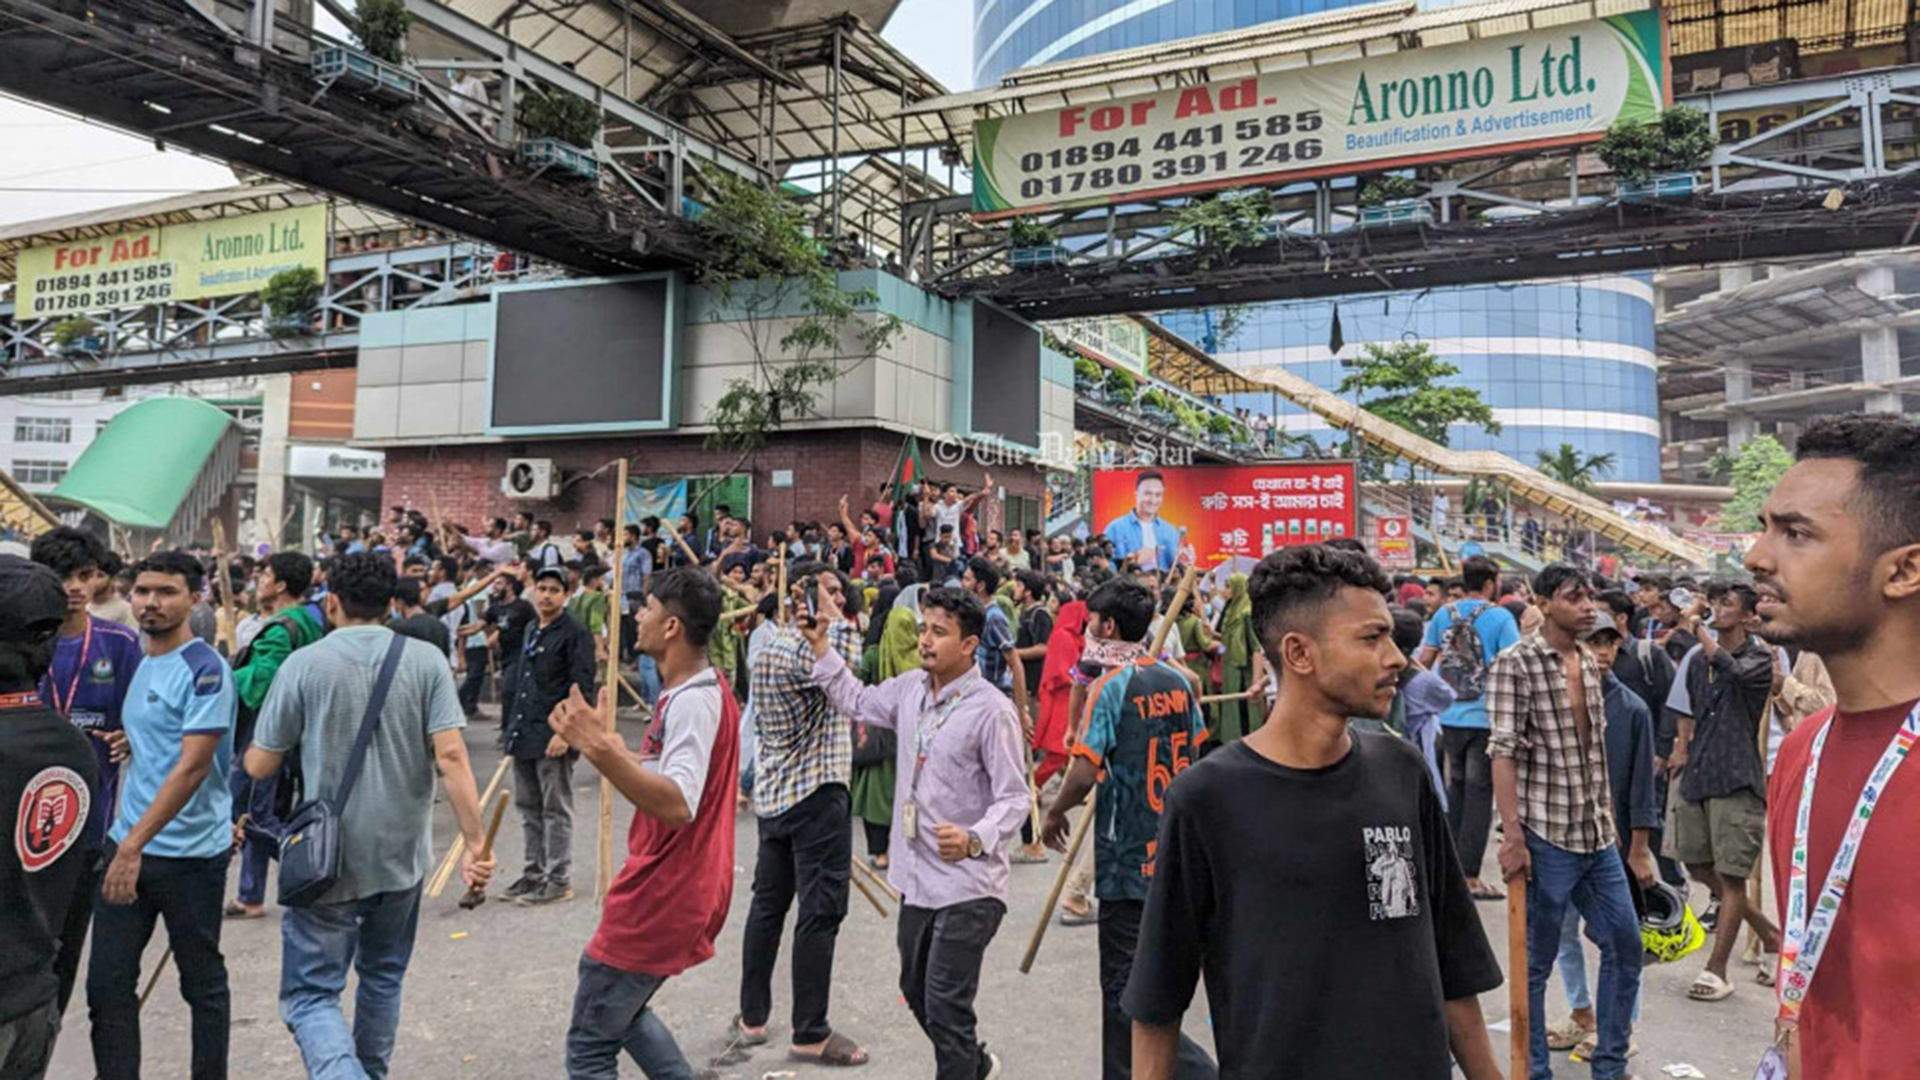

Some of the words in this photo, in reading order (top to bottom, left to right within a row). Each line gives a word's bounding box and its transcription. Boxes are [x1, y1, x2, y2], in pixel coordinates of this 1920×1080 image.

[1347, 67, 1494, 125] Aronno
[1508, 35, 1597, 103] Ltd.
[1058, 100, 1156, 138] For
[1174, 78, 1278, 119] Ad.
[1345, 121, 1450, 150] Beautification
[1455, 118, 1467, 136] &
[1471, 103, 1593, 134] Advertisement
[1021, 137, 1141, 173] 01894
[1153, 124, 1223, 153] 441
[1235, 110, 1323, 141] 585
[1020, 164, 1141, 199] 01780
[1152, 151, 1227, 181] 391
[1239, 138, 1323, 168] 246
[54, 244, 103, 270] For
[110, 235, 160, 263] Ad.
[201, 231, 263, 263] Aronno
[268, 219, 305, 255] Ltd.
[34, 288, 91, 312] 01780
[96, 286, 130, 306] 391
[135, 282, 171, 302] 246
[35, 272, 91, 294] 01894
[96, 267, 130, 288] 441
[132, 262, 172, 283] 585
[1272, 494, 1317, 510] আমার
[1320, 491, 1344, 509] চাই
[1362, 826, 1411, 844] PABLO
